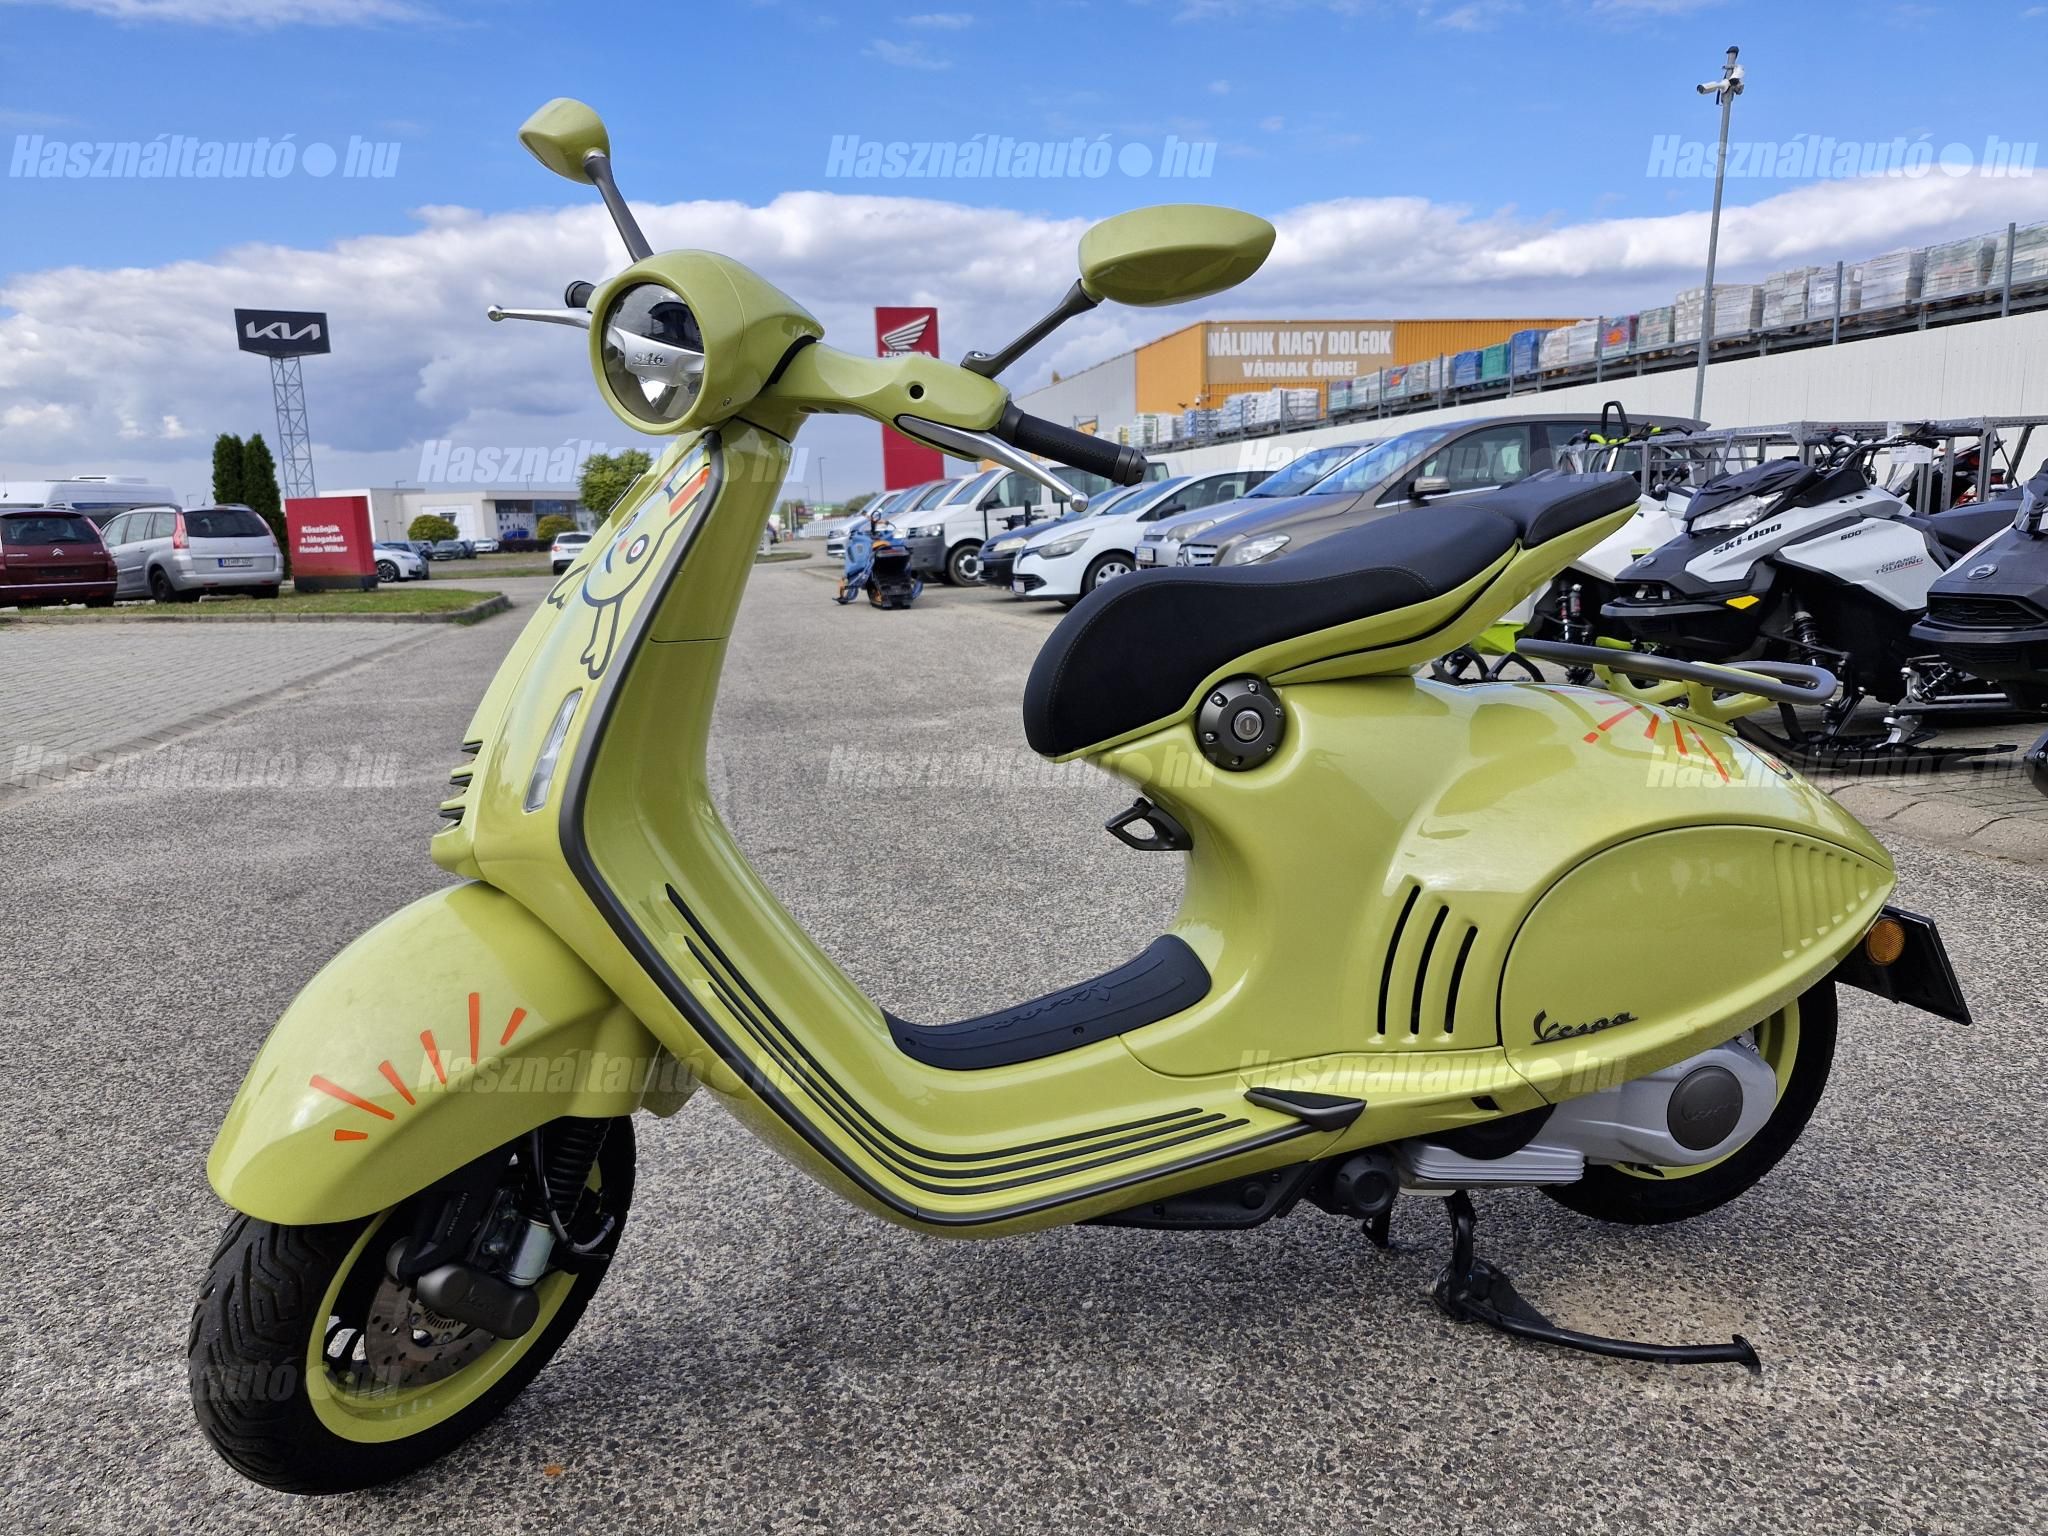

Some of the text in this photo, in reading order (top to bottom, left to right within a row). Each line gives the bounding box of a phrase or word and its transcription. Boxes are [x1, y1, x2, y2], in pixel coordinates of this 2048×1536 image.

[245, 321, 321, 341] KIA
[1208, 327, 1392, 356] NÁLUNK NAGY DOLGOK
[1242, 359, 1358, 377] VÁRNAK ÖNRE!
[1875, 558, 1924, 575] TOURING
[1530, 1008, 1639, 1046] Vespa
